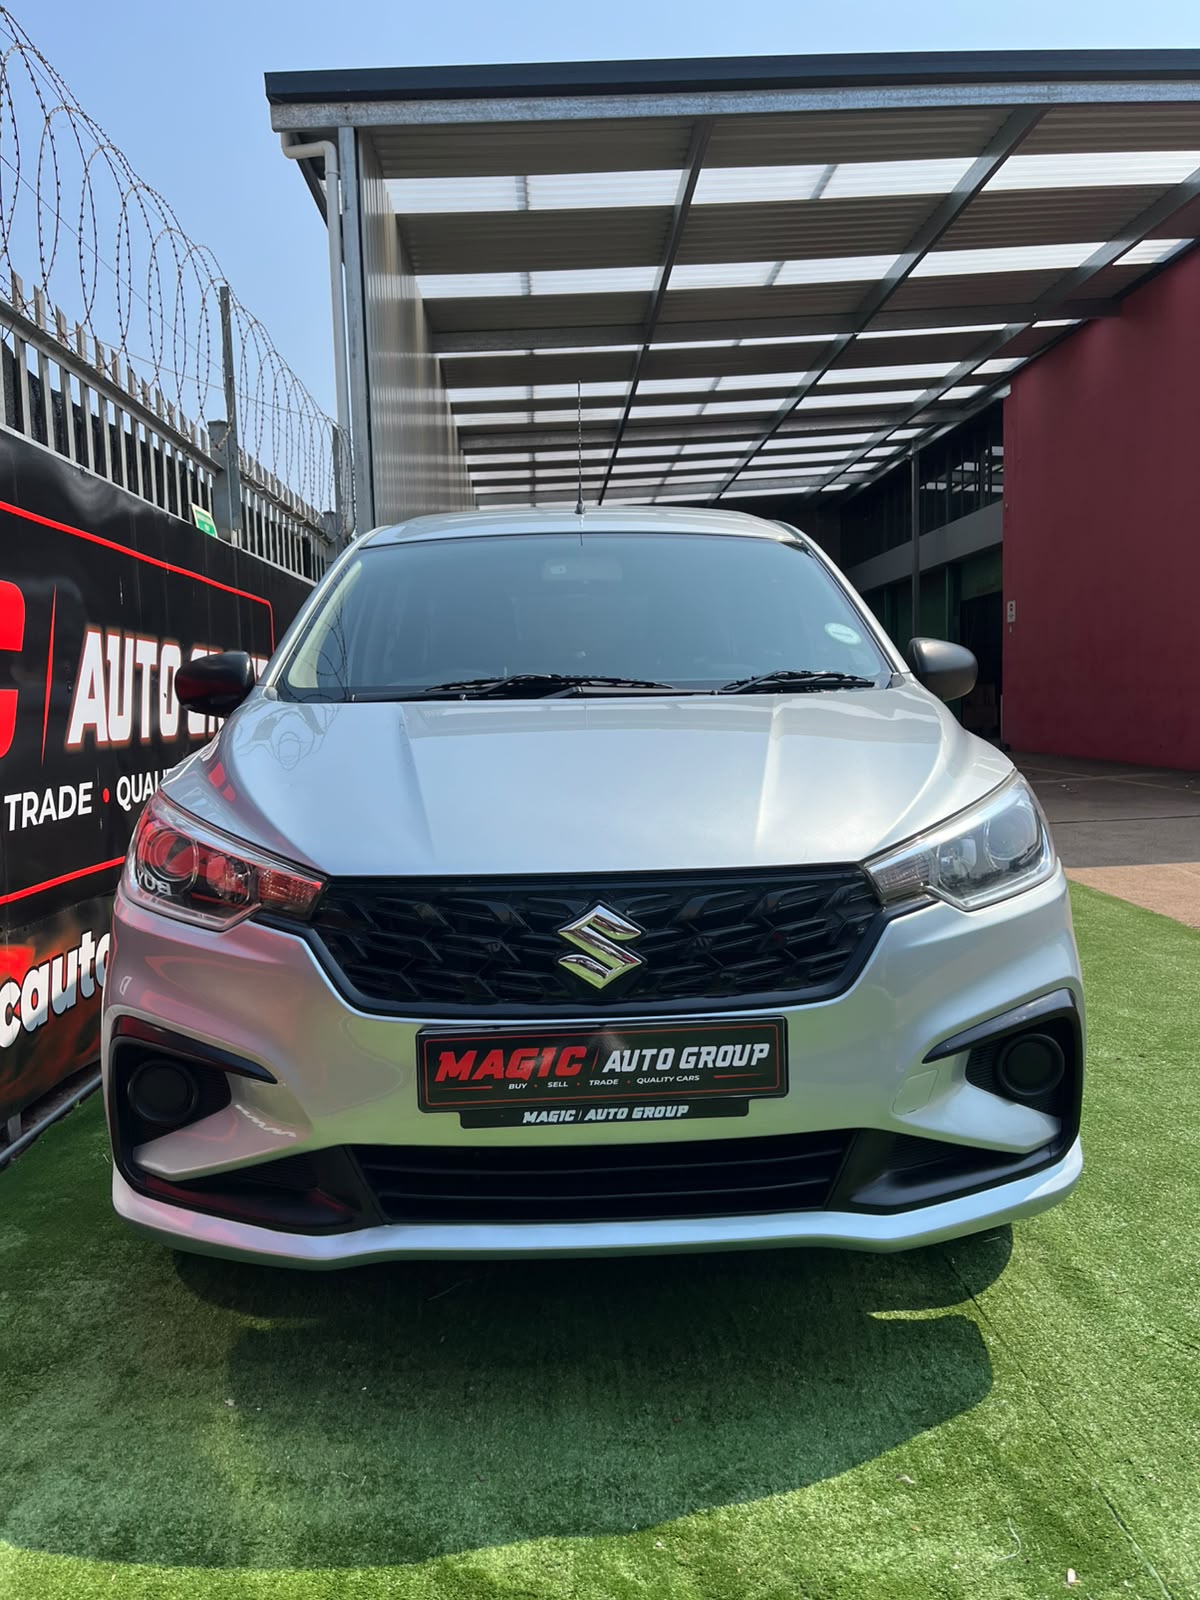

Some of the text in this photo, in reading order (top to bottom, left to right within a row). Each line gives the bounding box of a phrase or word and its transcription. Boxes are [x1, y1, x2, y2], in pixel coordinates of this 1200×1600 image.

[65, 629, 182, 746] AUTO
[4, 768, 177, 832] TRADE QUAL
[434, 1043, 770, 1082] MAGIC AUTO GROUP
[508, 1082, 528, 1090] BUY
[636, 1075, 675, 1085] QUALITY
[676, 1074, 700, 1082] CARS
[522, 1105, 690, 1124] MAGIC AUTO GROUP
